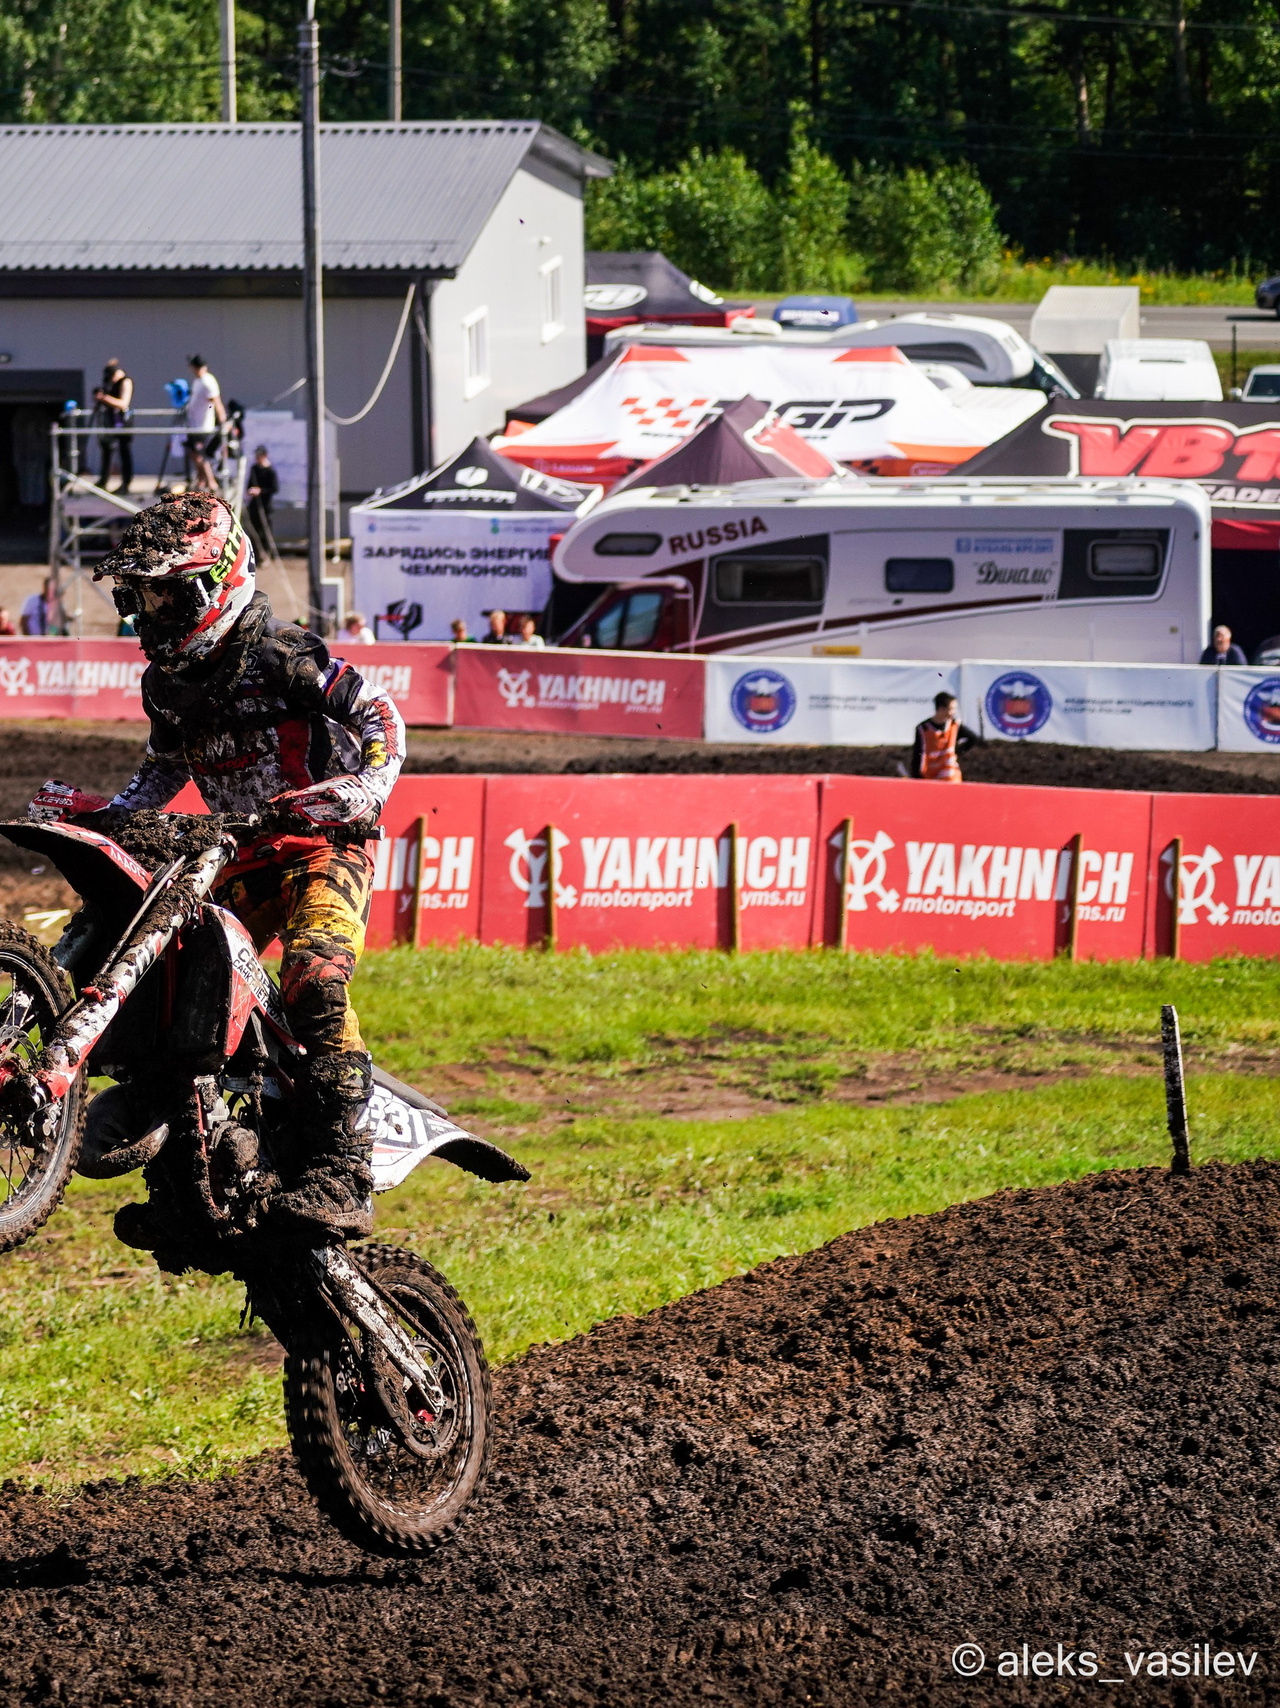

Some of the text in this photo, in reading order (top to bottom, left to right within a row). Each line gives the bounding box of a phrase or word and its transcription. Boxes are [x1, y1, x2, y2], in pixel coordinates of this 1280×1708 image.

[1050, 421, 1280, 482] VB1
[668, 516, 769, 556] RUSSIA
[363, 547, 466, 561] ЗАРЯДИСЬ
[401, 564, 528, 578] ЧЕМПИОНОВ!
[35, 661, 146, 689] YAKHNIC
[538, 674, 666, 705] YAKHNICH
[373, 837, 474, 891] NICH
[580, 836, 810, 890] YAKHNICH
[905, 841, 1135, 905] YAKHNICH
[581, 889, 806, 911] motorsport yms.ru
[902, 896, 1016, 918] motorsport
